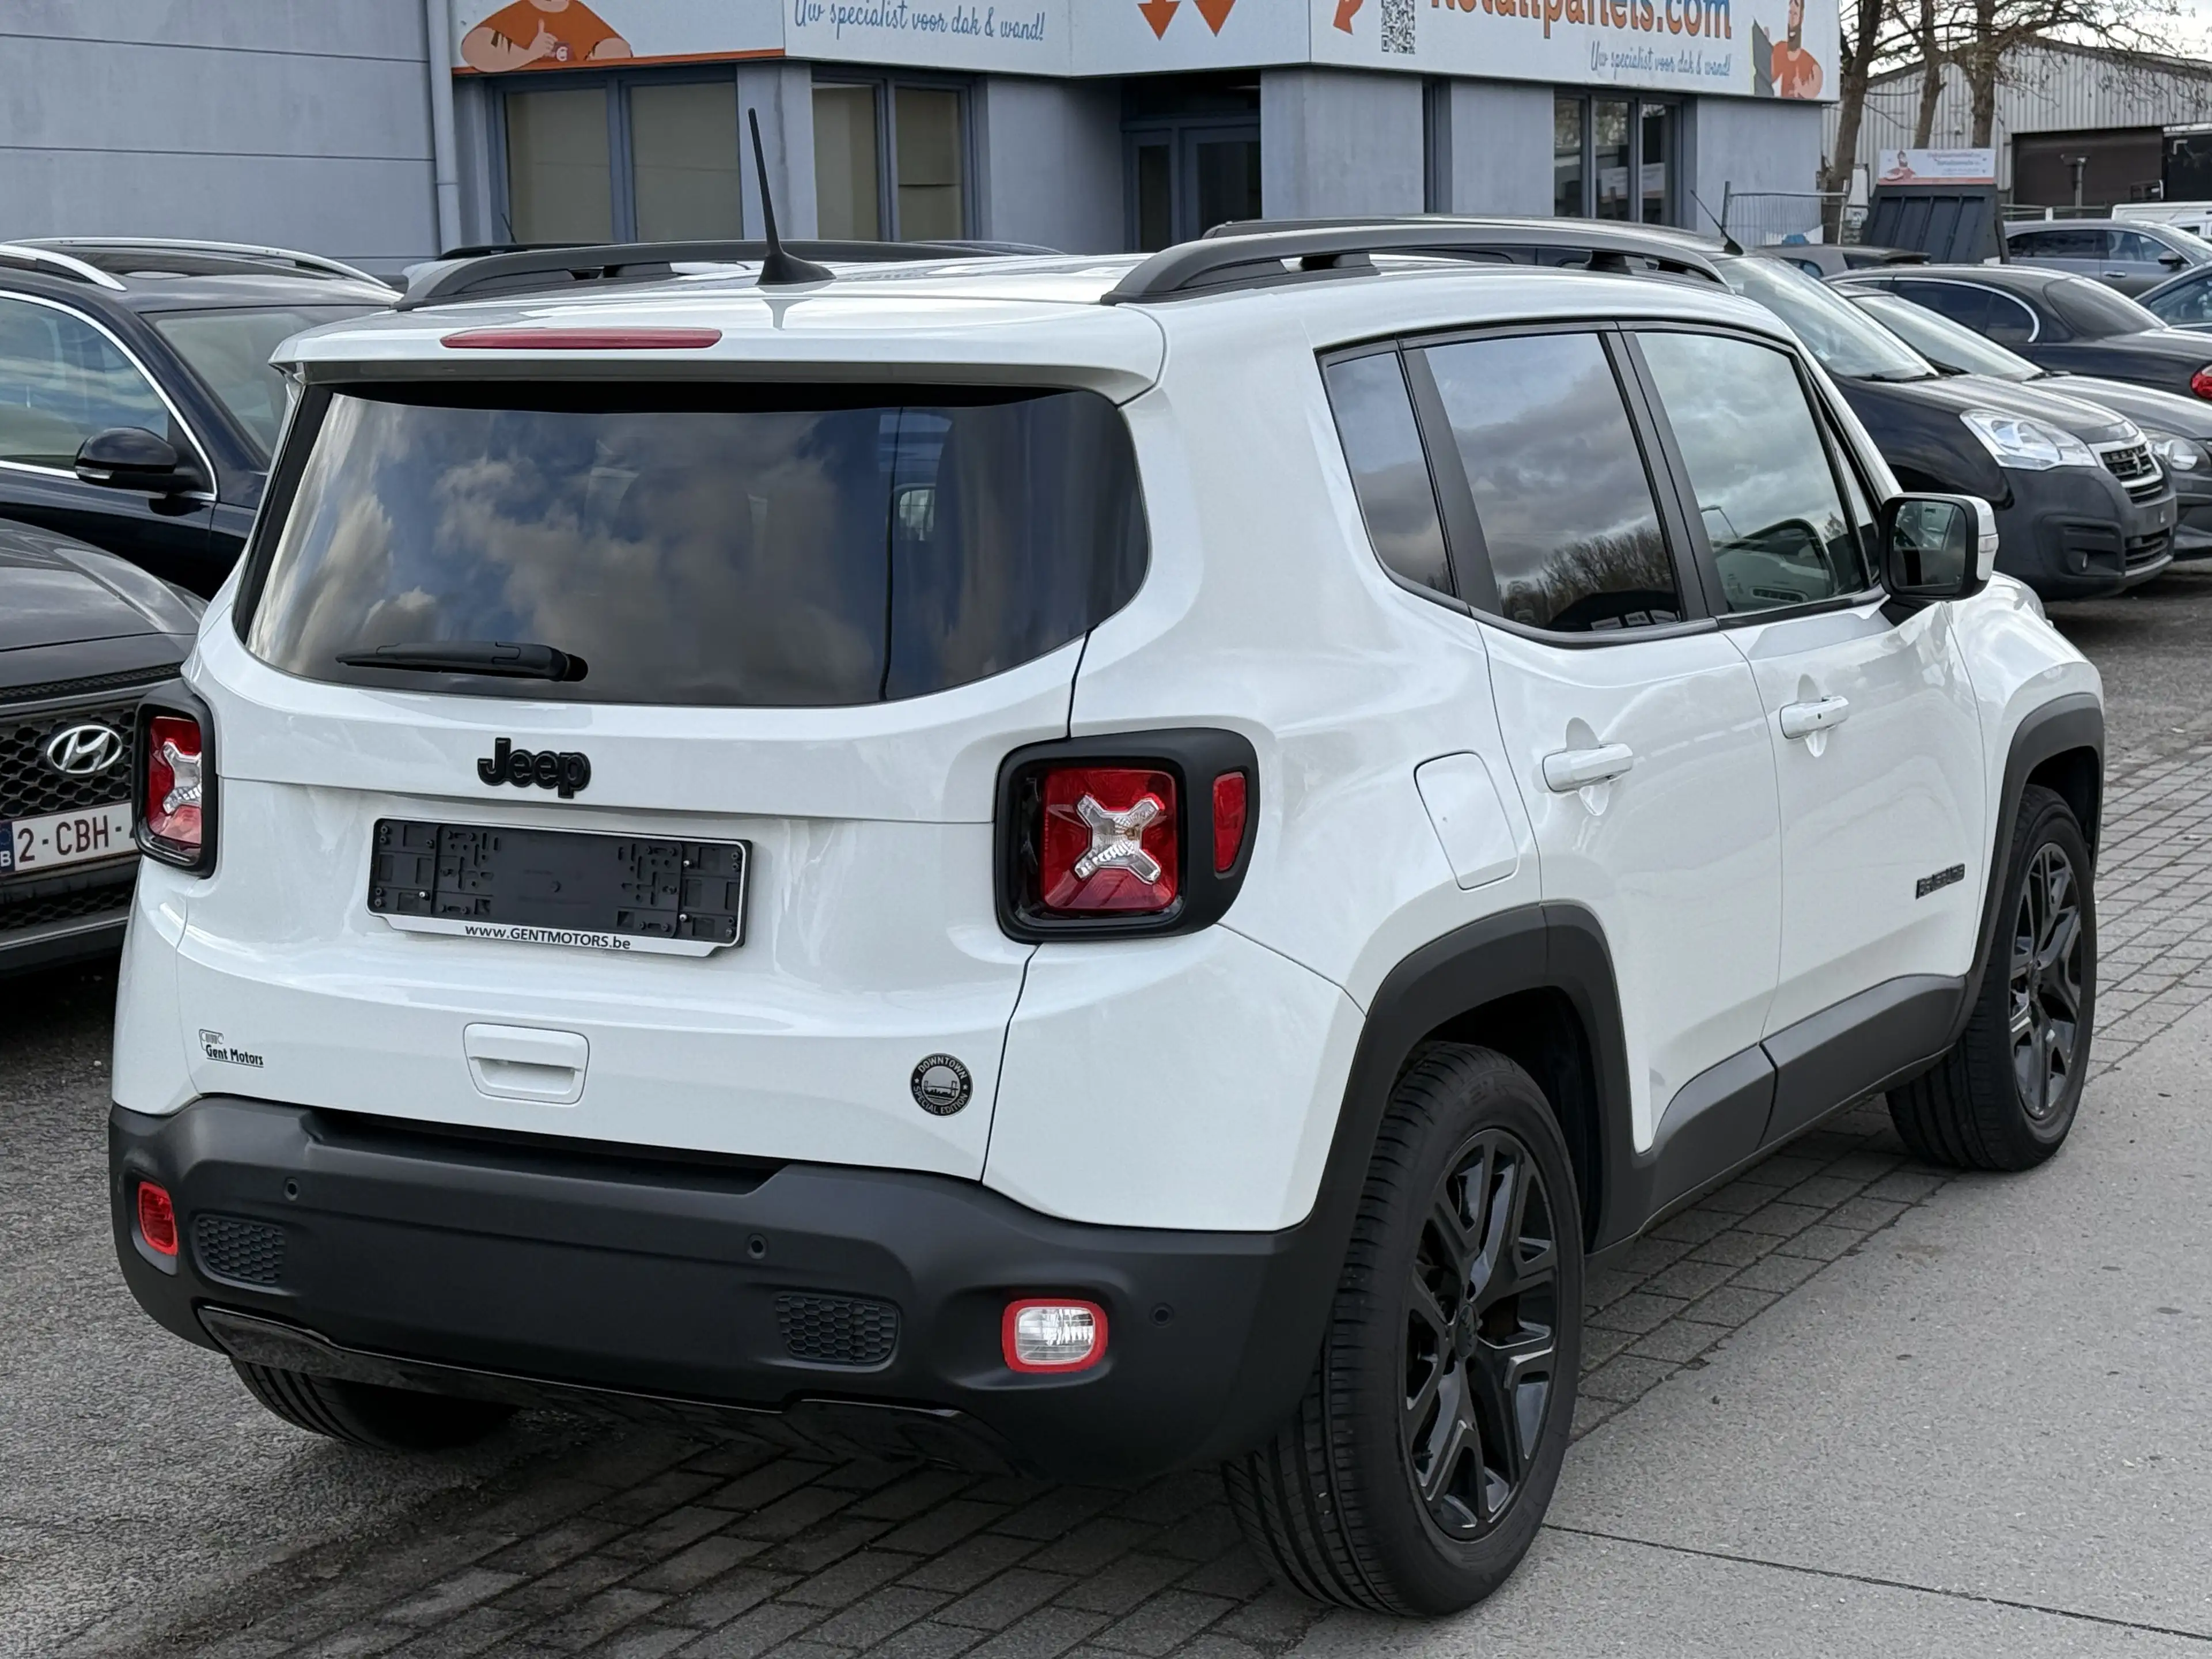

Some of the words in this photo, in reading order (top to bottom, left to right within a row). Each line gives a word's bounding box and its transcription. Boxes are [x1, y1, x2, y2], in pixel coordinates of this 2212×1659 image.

[794, 0, 824, 27] Uw
[830, 0, 908, 40] specialist
[912, 13, 948, 33] voor
[951, 6, 980, 36] dak
[984, 7, 995, 37] &
[1000, 12, 1046, 41] wand!
[1431, 0, 1732, 39] panels.com
[477, 737, 592, 799] Jeep
[17, 815, 136, 863] 2-CBH-
[0, 850, 12, 867] B
[465, 925, 631, 949] www.GENTMOTORS.be
[206, 1044, 228, 1060] Gent
[230, 1048, 264, 1065] Motors
[918, 1056, 968, 1080] DOWNTOWN
[912, 1085, 939, 1114] SPECIAL
[940, 1093, 968, 1114] EDITION
